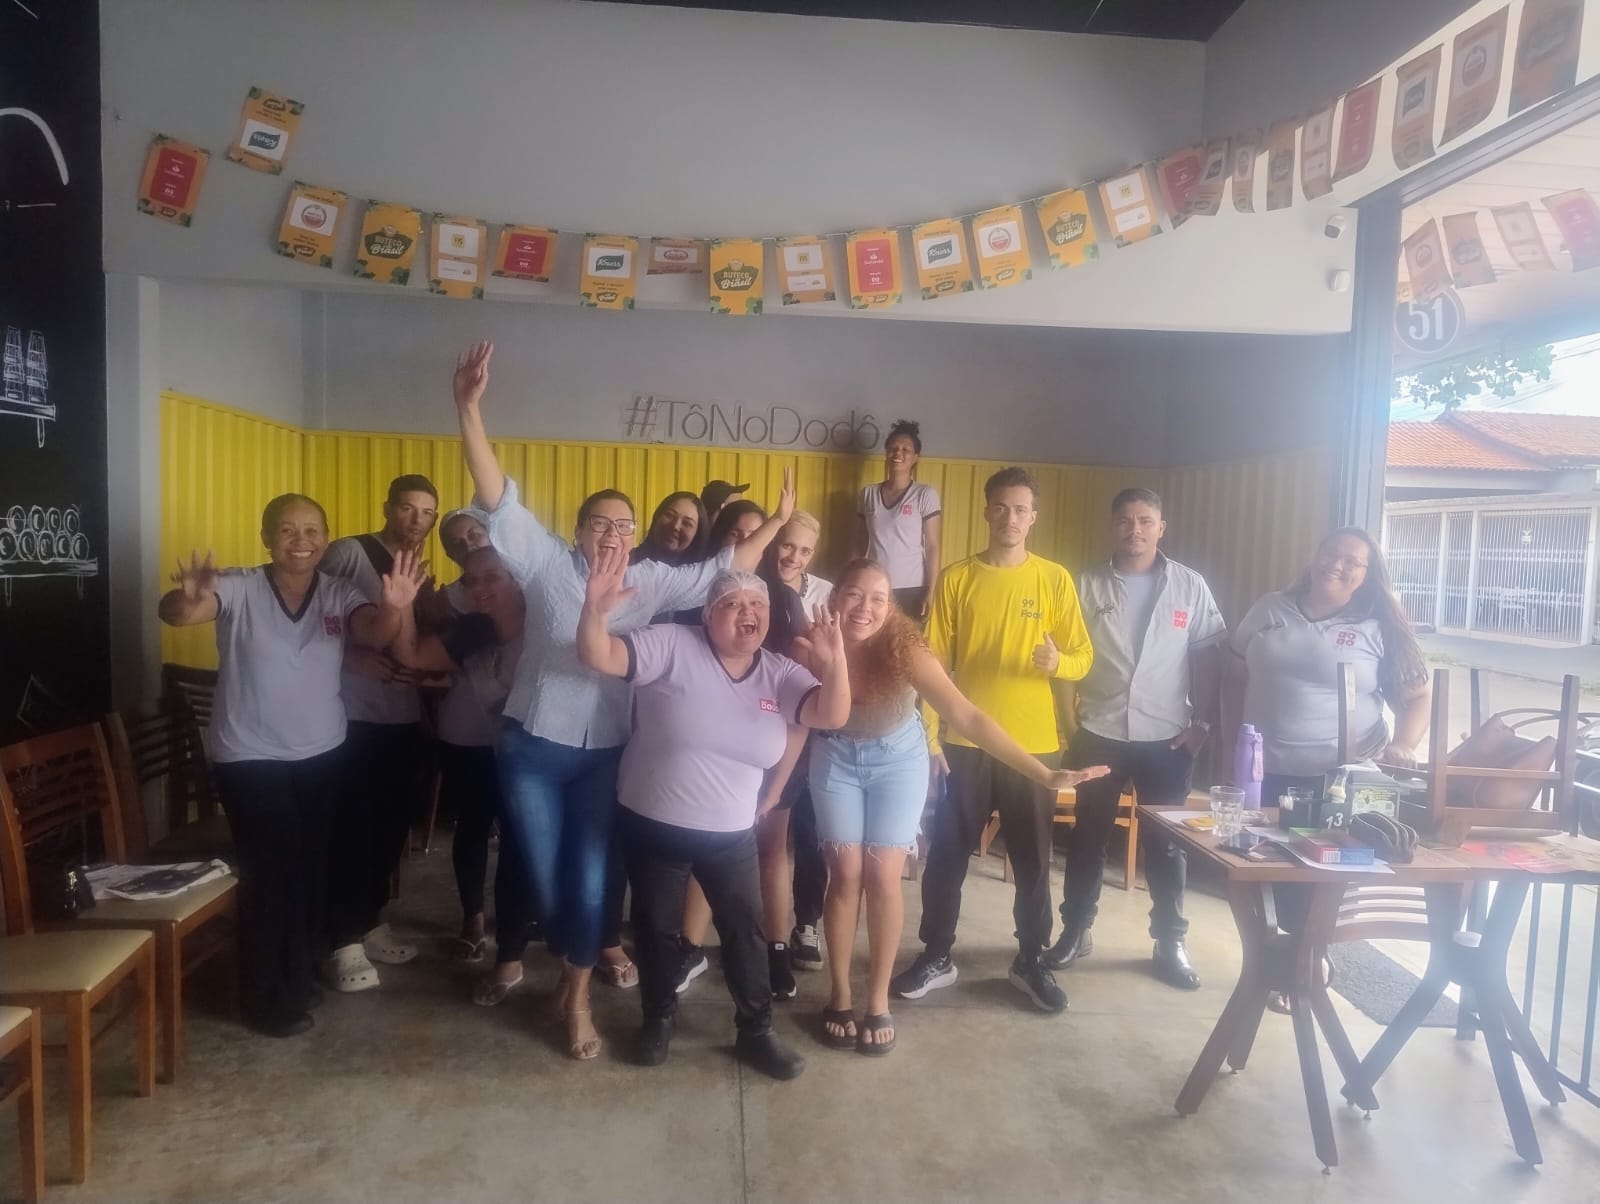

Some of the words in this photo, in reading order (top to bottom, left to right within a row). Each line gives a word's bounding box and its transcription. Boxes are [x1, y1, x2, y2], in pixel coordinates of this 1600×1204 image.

[369, 243, 405, 256] Brasil
[723, 271, 750, 279] BUTECO
[720, 276, 753, 290] Brasil
[1408, 296, 1444, 341] 51
[623, 395, 881, 450] #TôNoDodô
[1022, 599, 1034, 608] 99
[1325, 812, 1344, 830] 13
